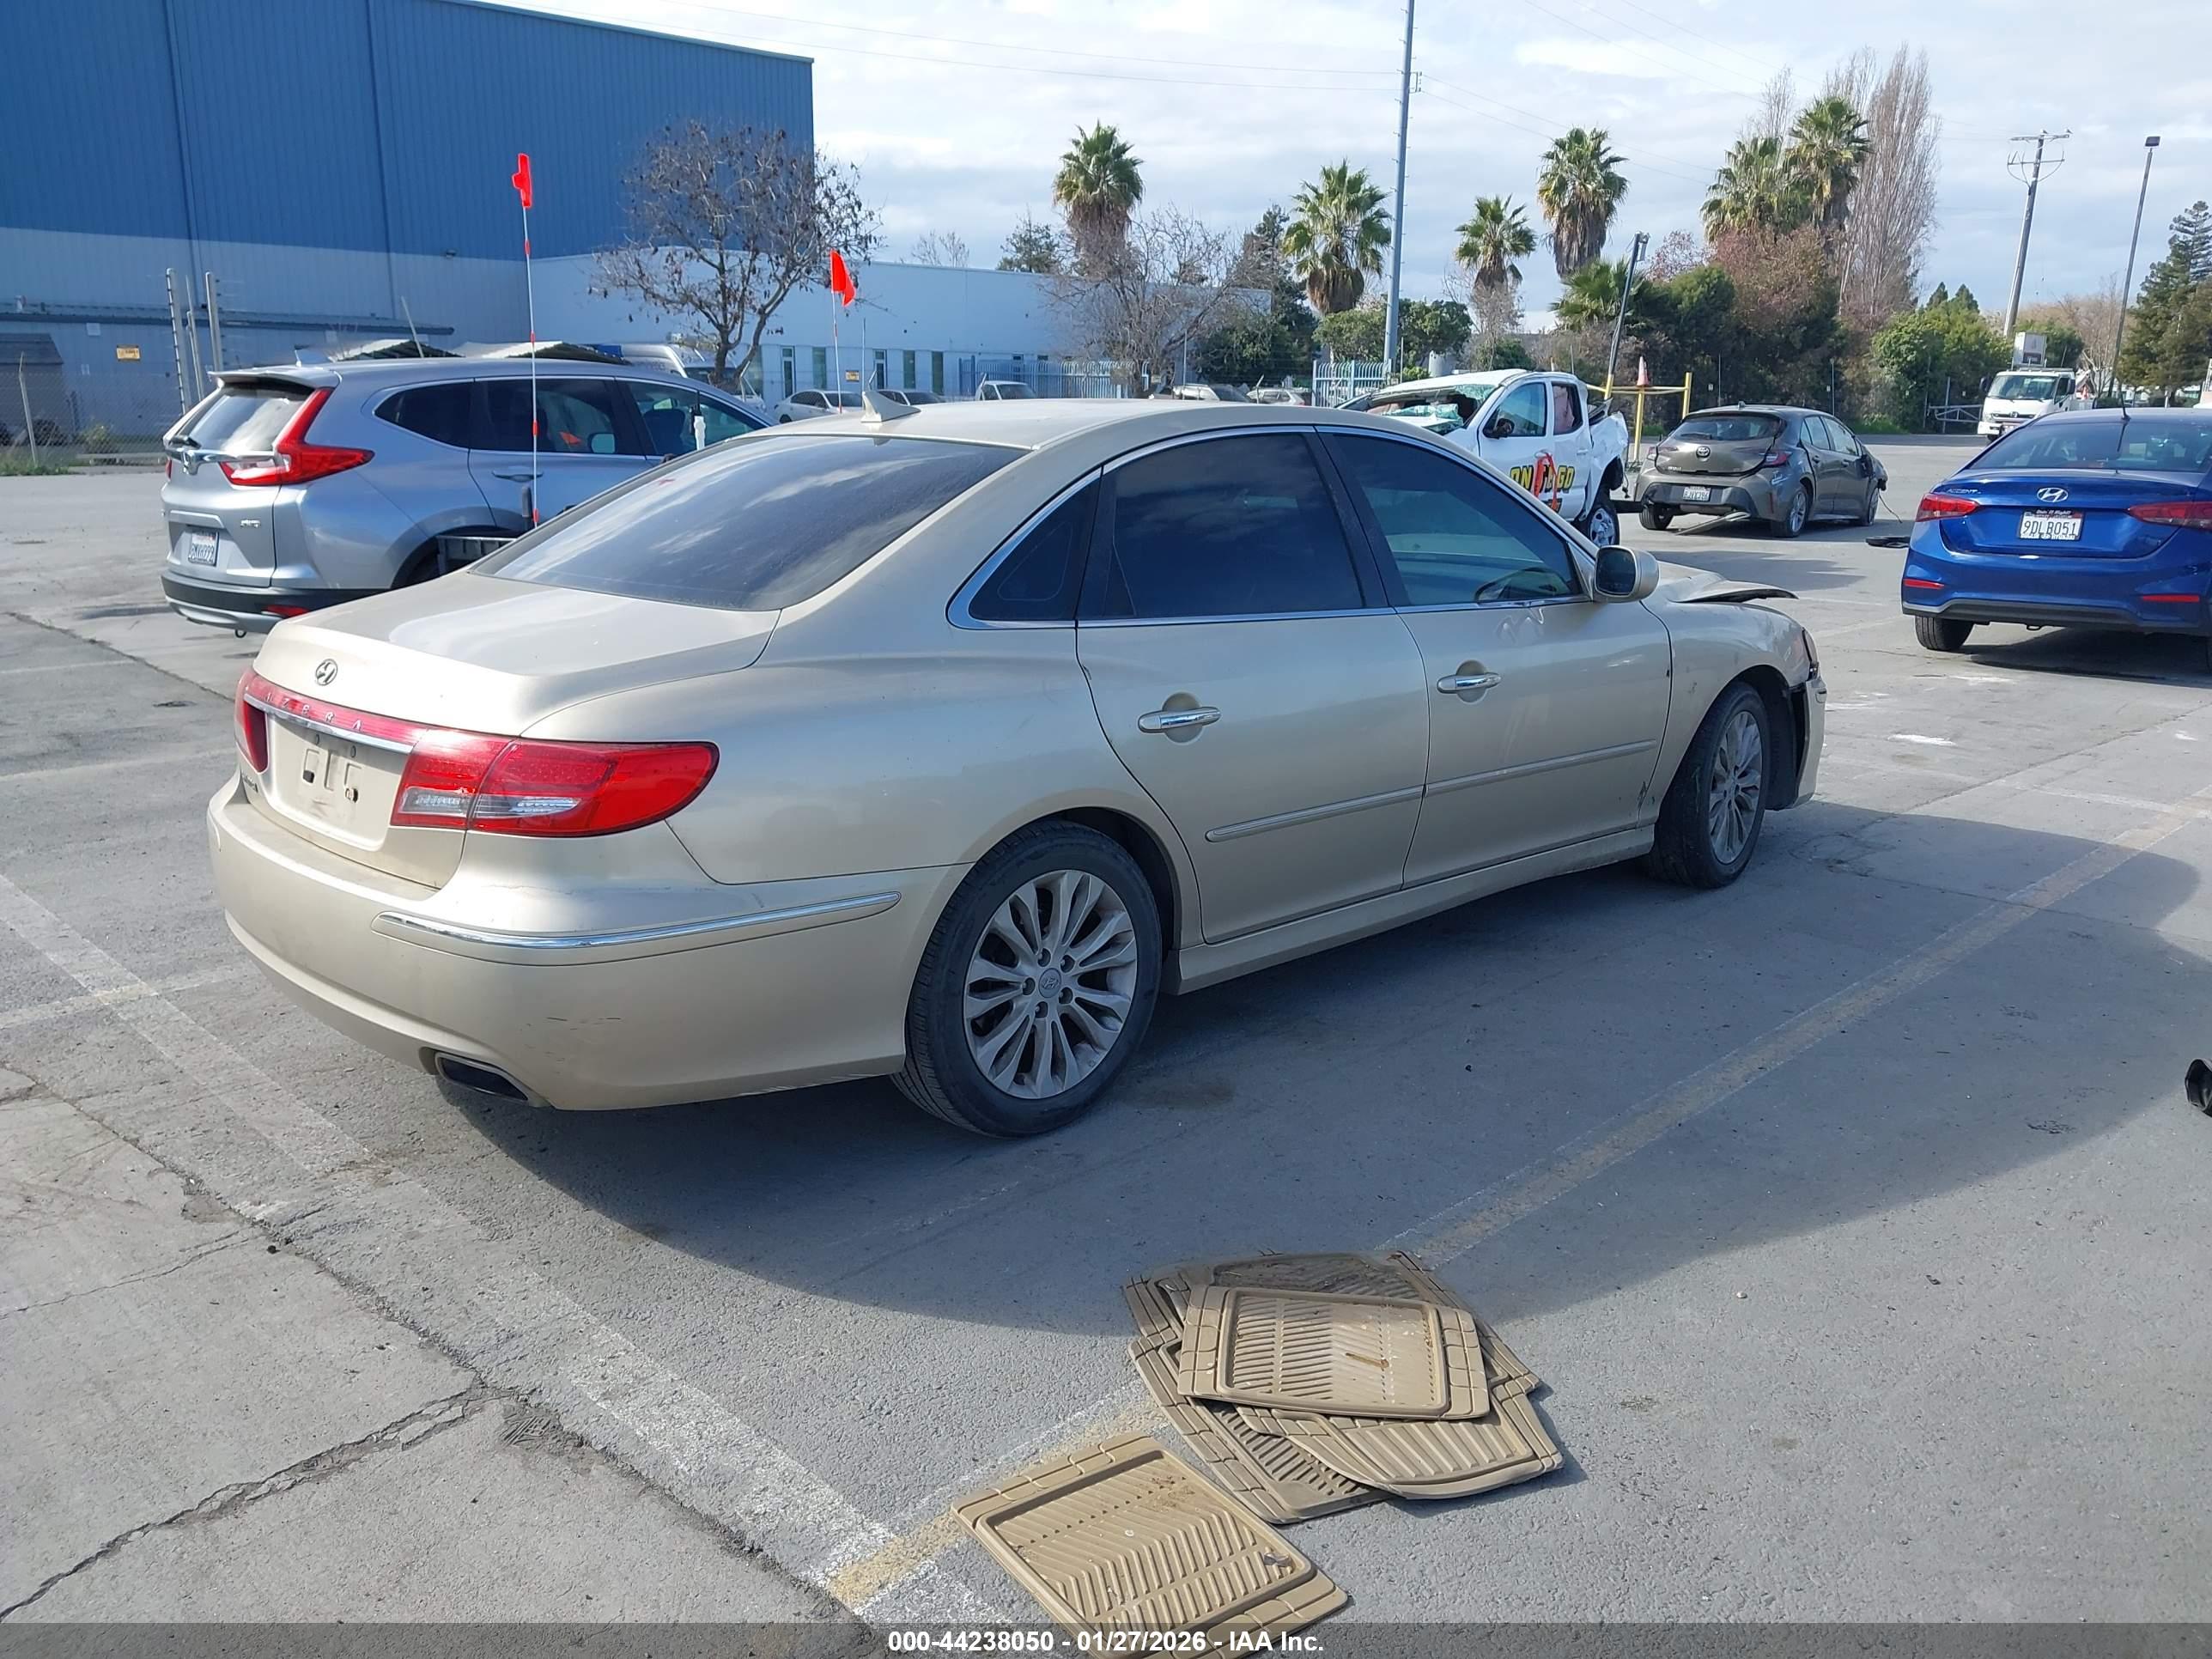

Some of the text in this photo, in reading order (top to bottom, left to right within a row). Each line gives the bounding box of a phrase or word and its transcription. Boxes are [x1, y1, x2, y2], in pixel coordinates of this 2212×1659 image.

[1510, 465, 1534, 491] ON
[1556, 465, 1575, 490] GO
[2023, 520, 2076, 535] 9DLB051
